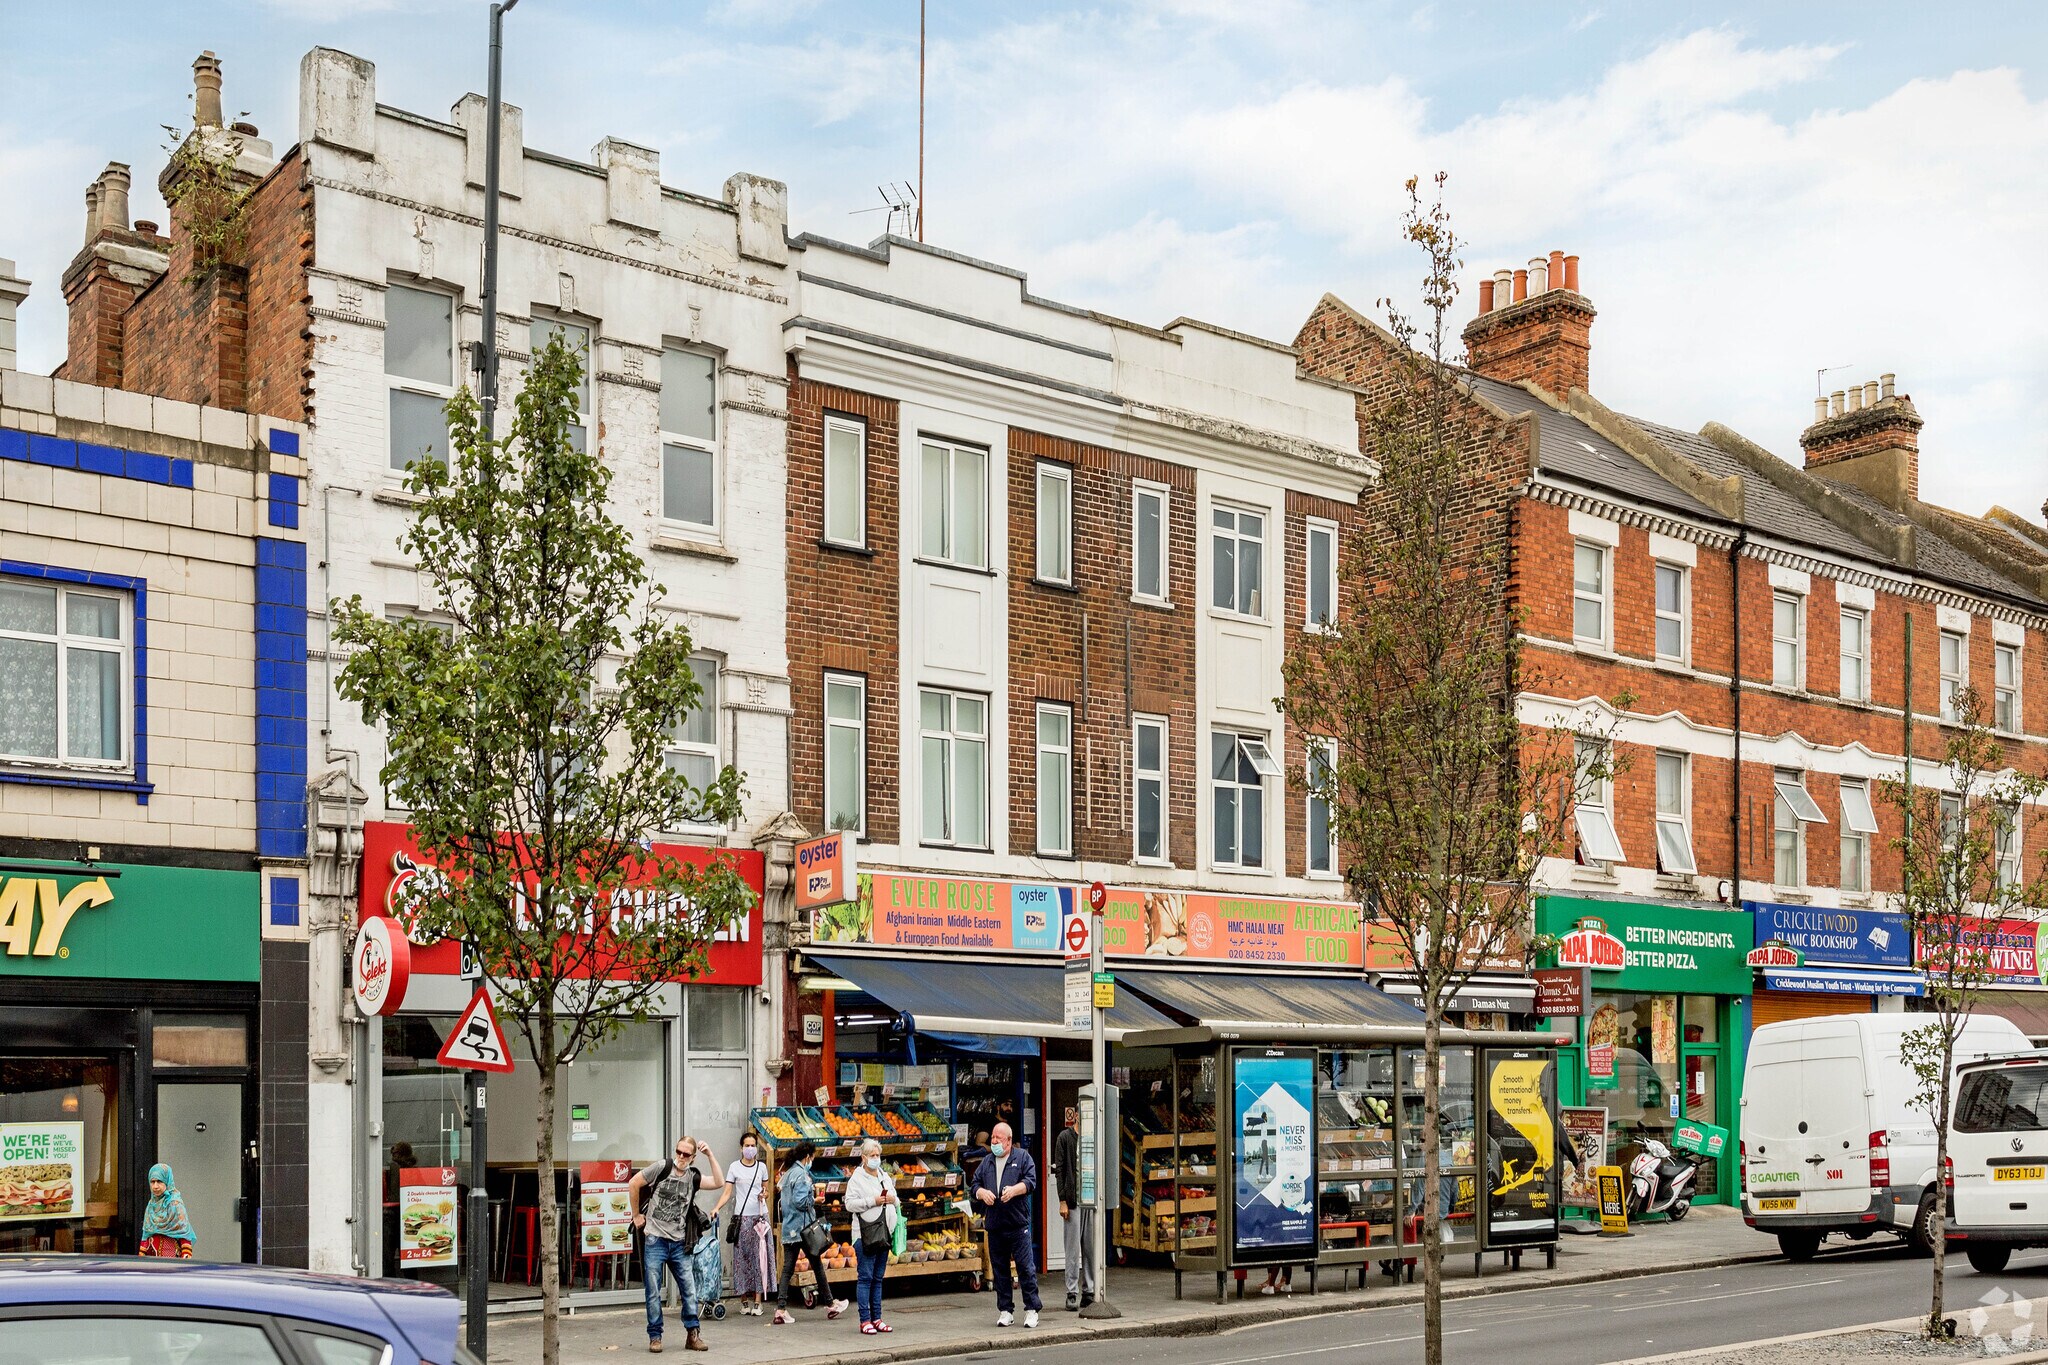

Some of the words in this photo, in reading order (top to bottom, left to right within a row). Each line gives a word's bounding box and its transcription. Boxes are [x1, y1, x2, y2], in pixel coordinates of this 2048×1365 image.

[800, 841, 838, 868] oyster
[891, 879, 939, 909] EVER
[947, 882, 995, 912] ROSE
[1019, 888, 1047, 905] oyster
[1092, 889, 1102, 902] BP
[0, 876, 114, 956] AY
[886, 911, 915, 928] Afghani
[917, 914, 943, 927] Iranian
[947, 915, 972, 928] Middle
[974, 917, 1001, 929] Eastern
[1219, 900, 1288, 922] SUPERMARKET
[1294, 905, 1359, 933] AFRICAN
[1774, 909, 1858, 934] CRICKLEWOOD
[1227, 921, 1244, 933] HMC
[1246, 922, 1266, 935] HALAL
[1267, 924, 1284, 935] MEAT
[1584, 920, 1601, 929] PIZZA
[896, 931, 902, 943] &
[904, 930, 939, 946] European
[941, 932, 959, 945] Food
[961, 933, 994, 947] Available
[1104, 927, 1127, 946] OOD
[1626, 926, 1665, 944] BETTER
[1667, 929, 1735, 949] INGREDIENTS.
[1773, 931, 1808, 947] ISLAMIC
[1810, 934, 1858, 950] BOOKSHOP
[1229, 950, 1244, 959] 020
[1245, 950, 1265, 960] 8452
[1267, 951, 1286, 961] 2330
[1305, 936, 1349, 963] FOOD
[1560, 935, 1588, 963] PAPA
[1589, 933, 1624, 966] JOHNS
[1462, 957, 1480, 968] Swe
[1485, 958, 1504, 968] Coffee
[1508, 959, 1522, 969] Gifts
[1627, 951, 1665, 968] BETTER
[1666, 953, 1698, 969] PIZZA.
[1748, 950, 1768, 965] PAPA
[1770, 950, 1797, 965] JOHNS
[1990, 948, 2034, 971] WINE
[1538, 984, 1561, 996] Damas
[1562, 983, 1580, 995] Nut
[1776, 978, 1806, 989] Cricklewood
[1806, 980, 1825, 990] Muslim
[1824, 980, 1839, 990] Youth
[1839, 981, 1852, 991] Trust
[1854, 982, 1875, 993] Working
[1874, 982, 1882, 992] for
[1882, 983, 1890, 992] the
[1890, 983, 1917, 994] Community
[1472, 998, 1495, 1009] Damas
[1496, 999, 1510, 1010] Nut
[1541, 1006, 1551, 1014] 020
[1566, 1005, 1580, 1013] 5951
[807, 1021, 820, 1030] COP
[1503, 1075, 1523, 1084] Smooth
[479, 1088, 484, 1097] 2
[1499, 1085, 1532, 1094] international
[1503, 1097, 1522, 1105] money
[1507, 1107, 1532, 1115] transfers.
[1280, 1125, 1306, 1135] NEVER
[3, 1134, 50, 1147] WE'RE
[1285, 1135, 1303, 1145] MISS
[3, 1147, 49, 1161] OPEN!
[1534, 1173, 1545, 1182] WU
[1758, 1172, 1800, 1183] GAUTIER
[1997, 1168, 2021, 1179] DY63
[1281, 1182, 1303, 1190] NORDIC
[1528, 1192, 1550, 1202] Western
[1603, 1194, 1619, 1203] MONEY
[1531, 1199, 1546, 1208] Union
[1604, 1202, 1621, 1214] HERE
[406, 1250, 412, 1259] 2
[421, 1249, 432, 1257] £4
